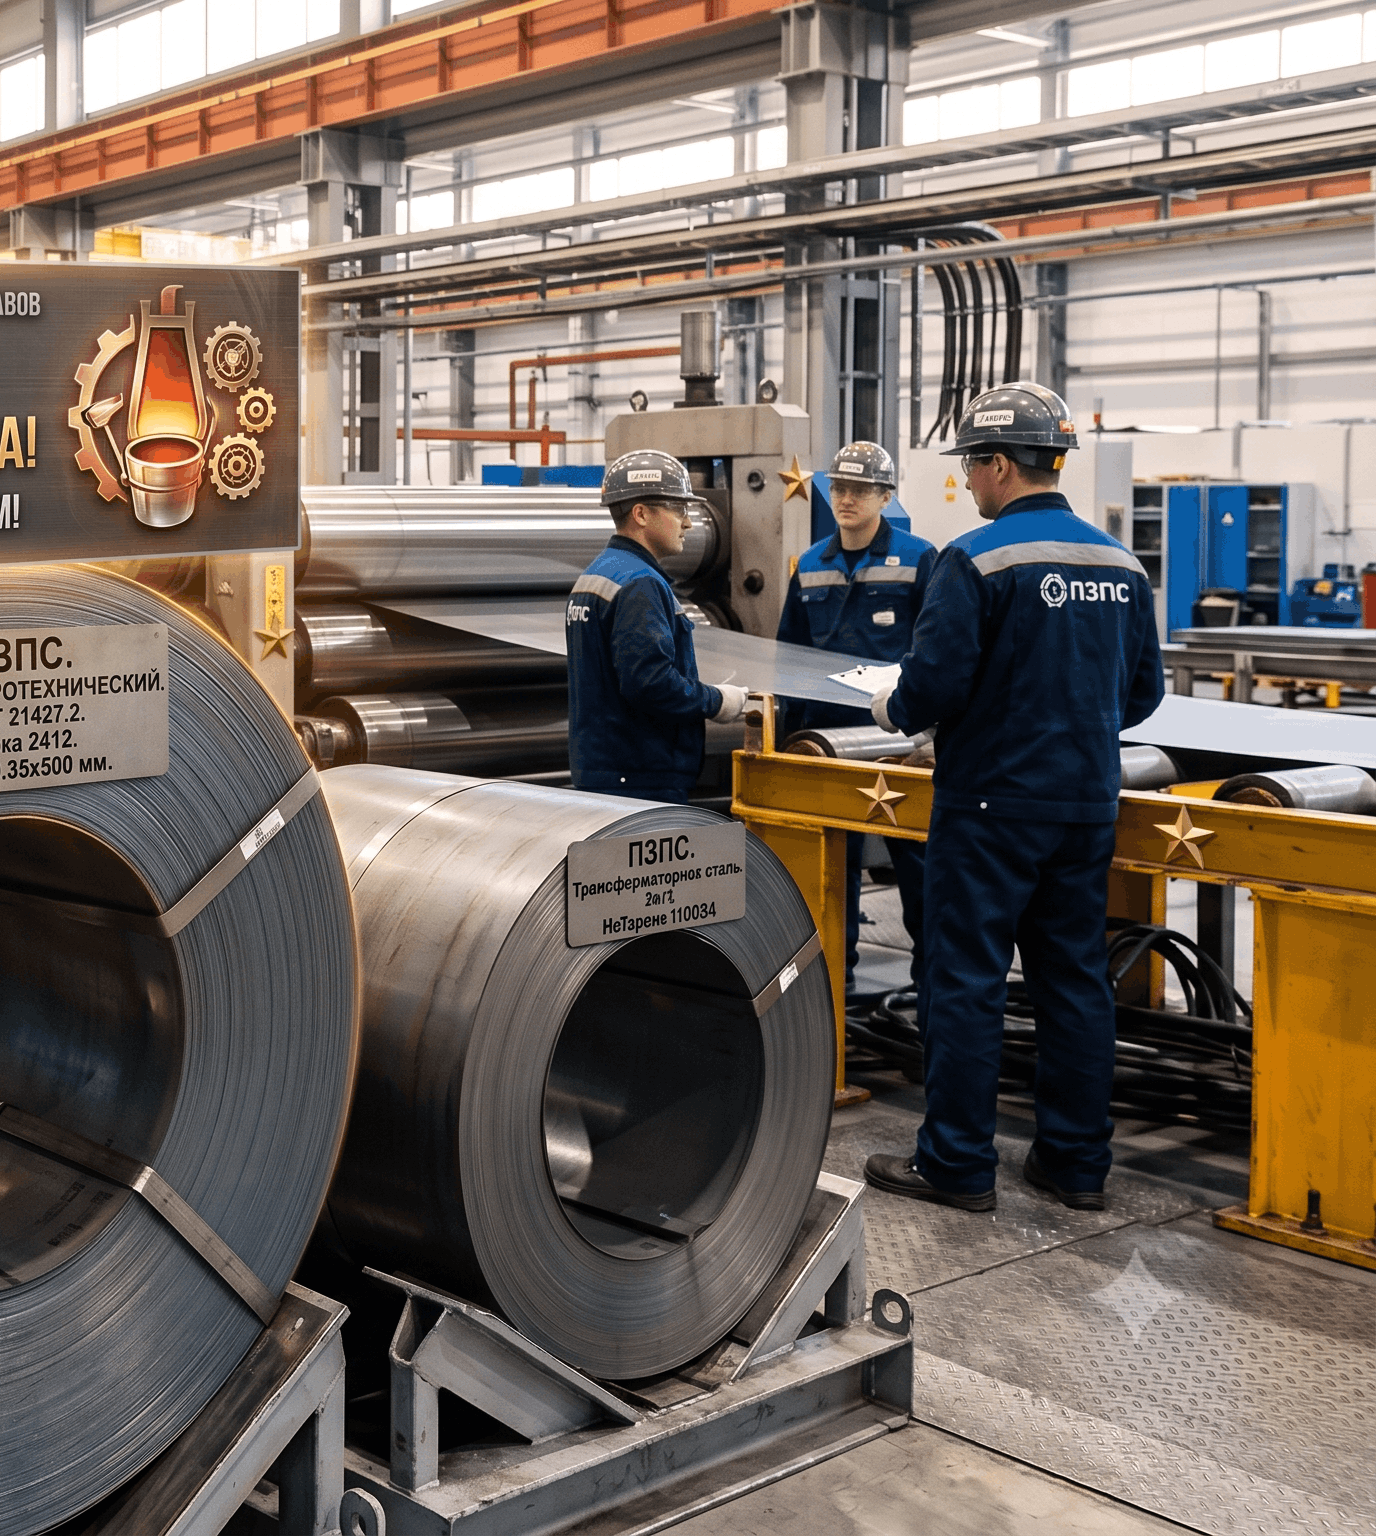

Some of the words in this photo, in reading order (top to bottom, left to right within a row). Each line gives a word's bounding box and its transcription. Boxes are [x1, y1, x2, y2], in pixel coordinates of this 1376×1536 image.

[1070, 581, 1129, 603] ПЗПС
[9, 703, 86, 727] 21427.2.
[28, 729, 78, 751] 2412.
[79, 757, 113, 773] мм.
[628, 835, 695, 868] ПЗПС.
[670, 902, 717, 924] 110034
